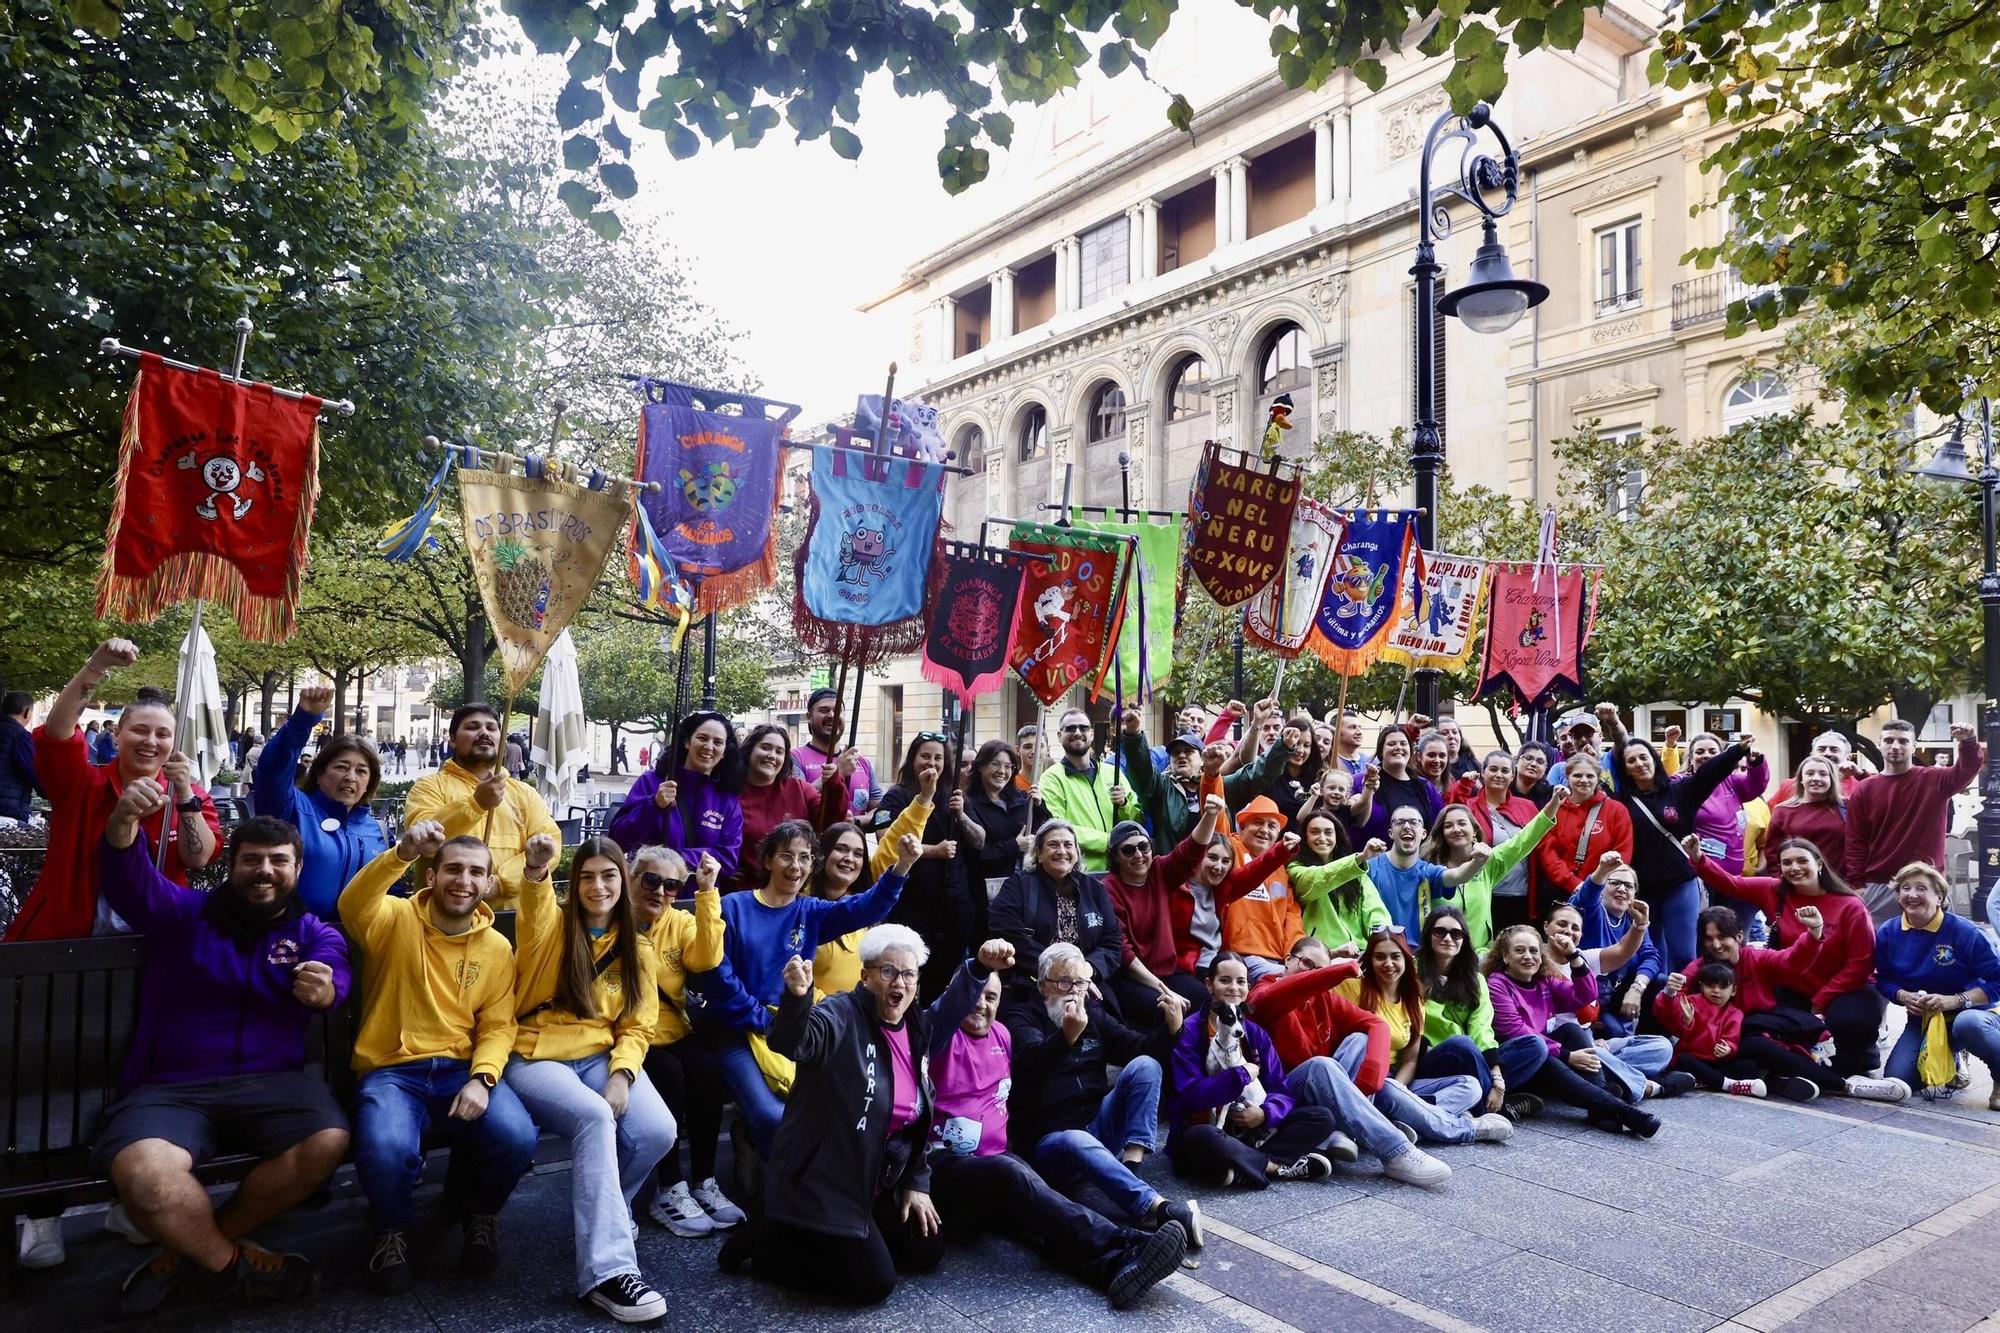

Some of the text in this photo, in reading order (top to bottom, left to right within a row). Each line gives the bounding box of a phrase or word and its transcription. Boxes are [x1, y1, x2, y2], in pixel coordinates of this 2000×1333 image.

[1216, 468, 1293, 504] XAREU
[1227, 498, 1267, 526] NEL
[475, 513, 494, 539] OS
[1207, 514, 1274, 552] ÑERU
[1341, 541, 1379, 552] Charanga
[1218, 551, 1274, 581] XOVE
[953, 578, 1003, 601] CHARANGA
[1205, 576, 1254, 603] XIXON
[1505, 588, 1568, 611] Charanga
[1249, 608, 1263, 631] LOS
[1323, 606, 1330, 617] La
[1350, 632, 1357, 640] y
[1455, 625, 1467, 638] LA
[1535, 649, 1560, 667] Vino
[856, 1043, 876, 1131] MARTA
